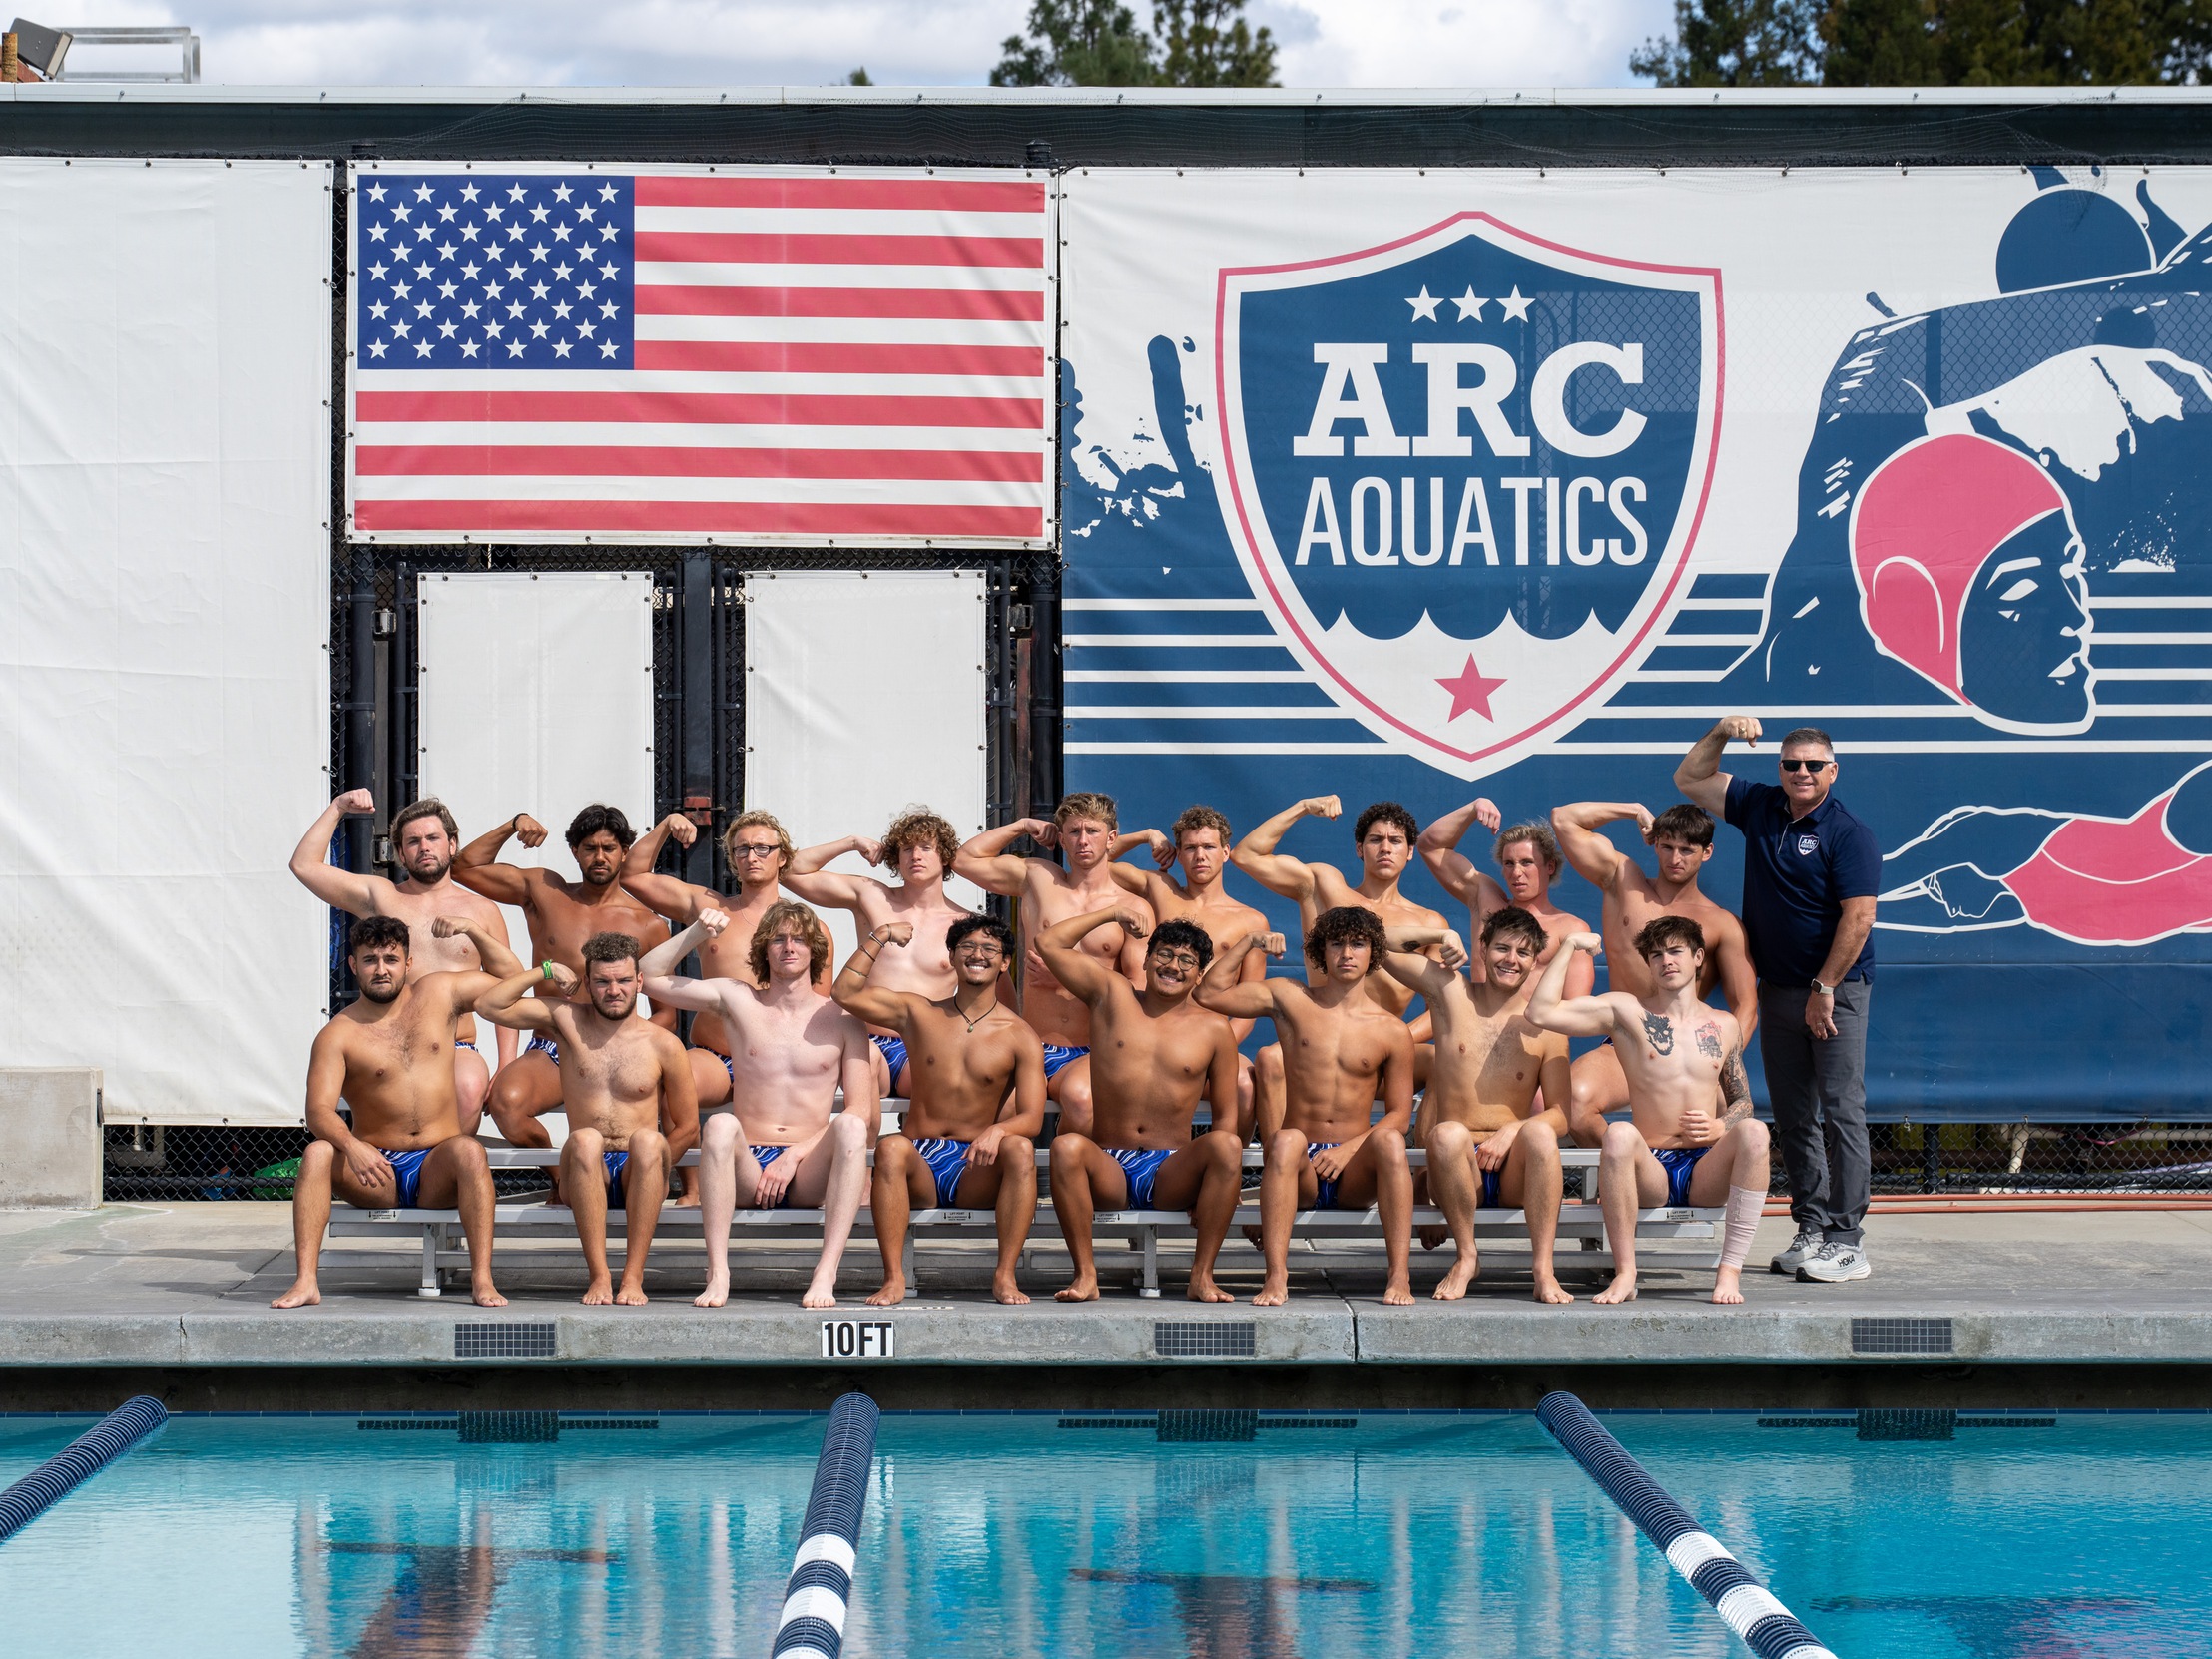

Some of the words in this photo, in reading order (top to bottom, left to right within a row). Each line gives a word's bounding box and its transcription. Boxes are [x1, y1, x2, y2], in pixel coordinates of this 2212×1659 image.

[1293, 340, 1648, 458] ARC
[1295, 476, 1648, 566] AQUATICS
[1837, 1254, 1855, 1268] HOKA
[824, 1322, 892, 1357] 10FT
